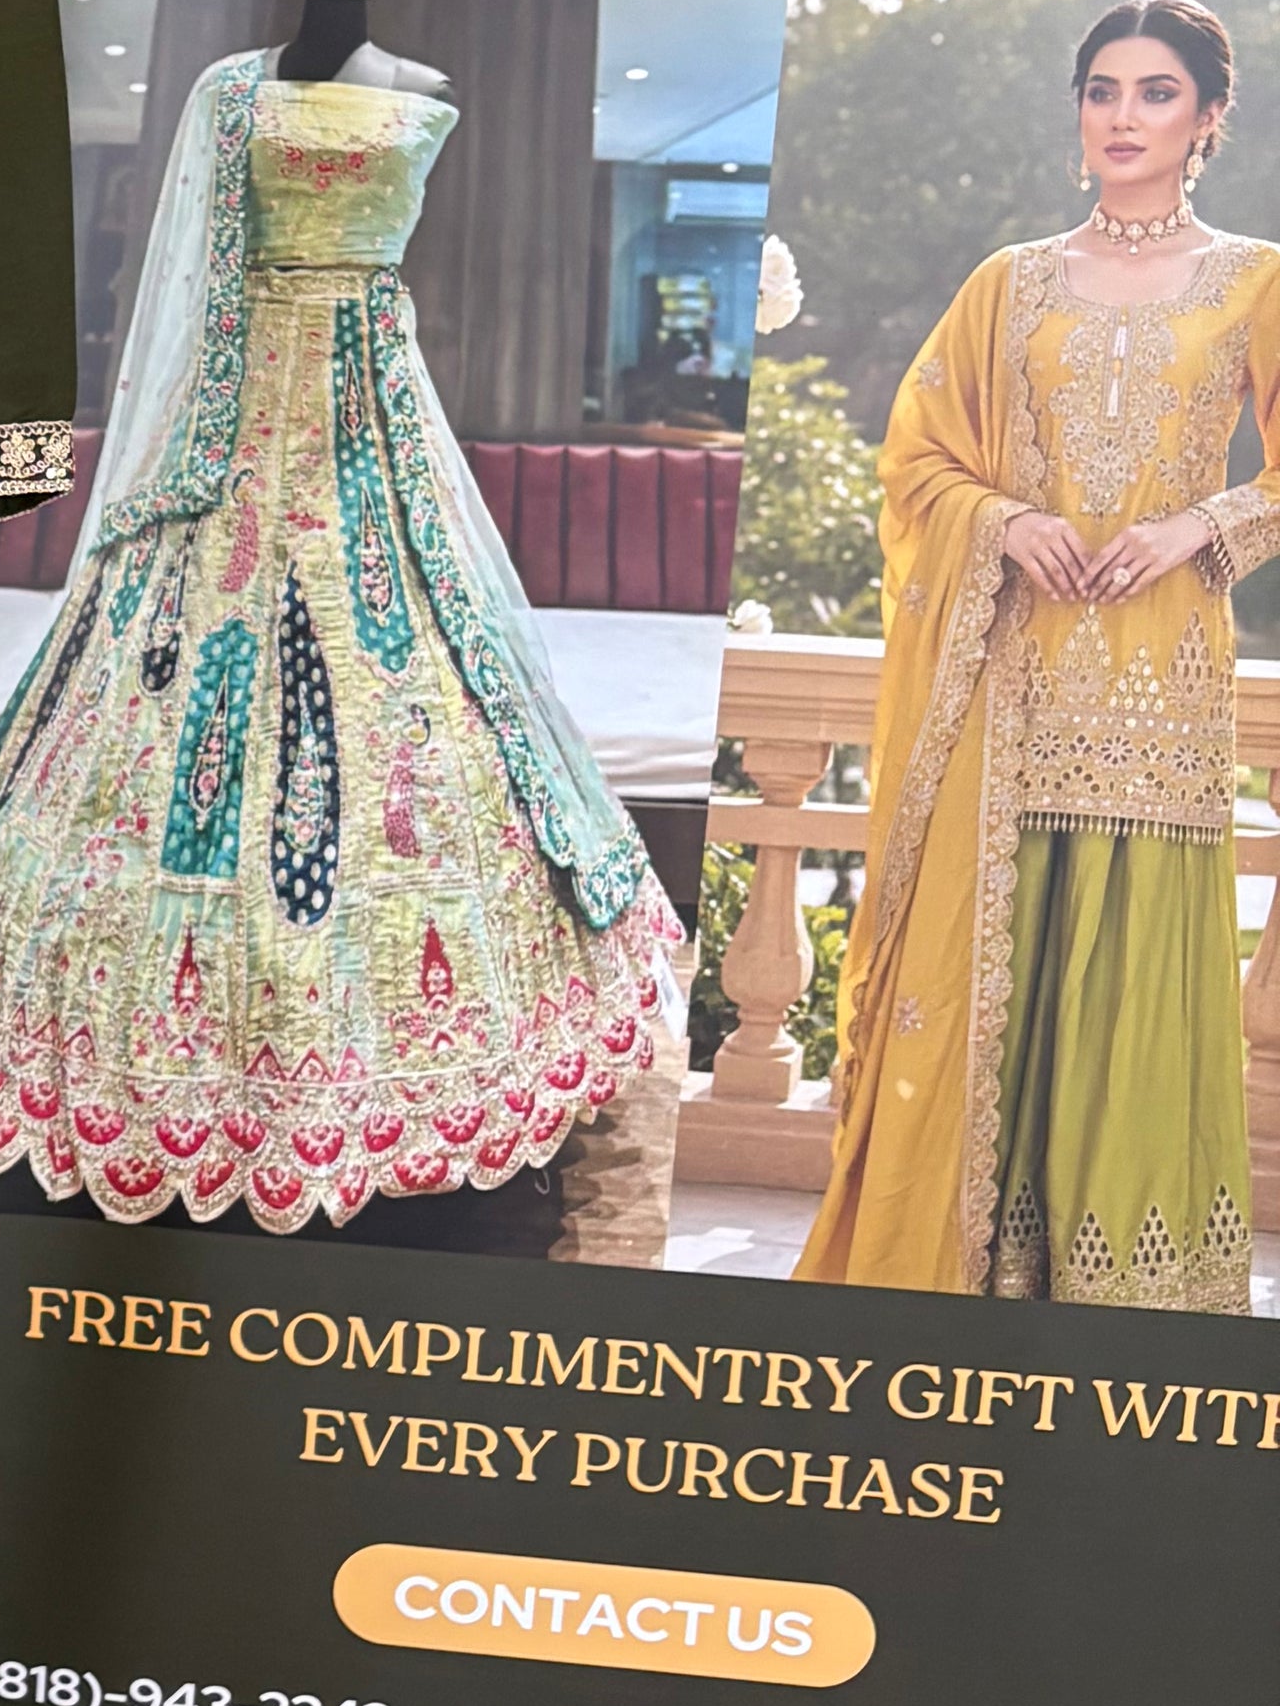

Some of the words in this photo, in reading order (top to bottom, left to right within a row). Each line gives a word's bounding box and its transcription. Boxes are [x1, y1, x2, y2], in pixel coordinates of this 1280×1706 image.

[25, 1287, 211, 1356] FREE
[230, 1309, 872, 1412] COMPLIMENTRY
[888, 1364, 1074, 1430] GIFT
[300, 1408, 557, 1481] EVERY
[571, 1433, 1003, 1523] PURCHASE
[394, 1575, 715, 1646] CONTACT
[728, 1605, 813, 1656] US
